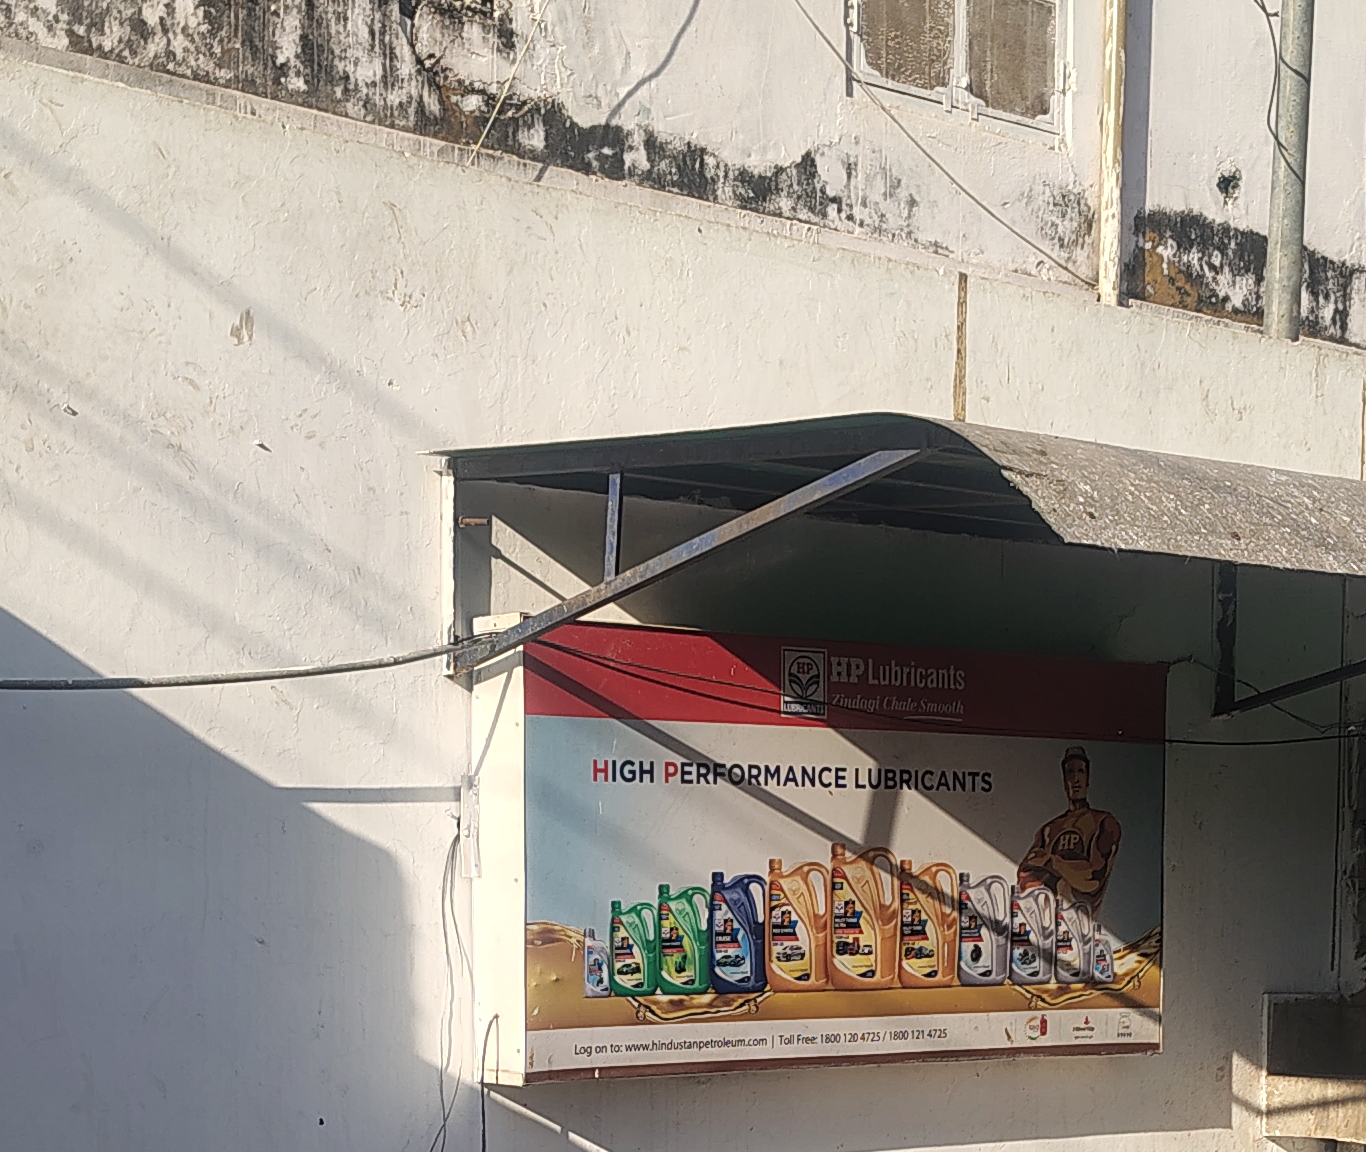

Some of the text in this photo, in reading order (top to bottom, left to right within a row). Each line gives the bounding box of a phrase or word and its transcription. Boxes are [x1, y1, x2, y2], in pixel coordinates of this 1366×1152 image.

[796, 661, 813, 675] HP
[830, 656, 965, 690] HP Lubricants
[832, 694, 964, 714] Zindagi Chale Smooth
[592, 759, 993, 792] HIGH PERFORMANCE LUBRICANTS
[1059, 833, 1079, 848] HP
[574, 1043, 592, 1057] Log
[595, 1044, 607, 1054] on
[610, 1043, 623, 1053] to:
[625, 1036, 767, 1052] www.hindustanpetroleum.com
[778, 1034, 795, 1046] Toll
[796, 1033, 817, 1045] Free:
[820, 1032, 841, 1044] 1800
[843, 1031, 859, 1043] 120
[859, 1031, 881, 1043] 4725
[889, 1029, 909, 1041] 1800
[911, 1029, 925, 1040] 121
[926, 1027, 948, 1039] 4725
